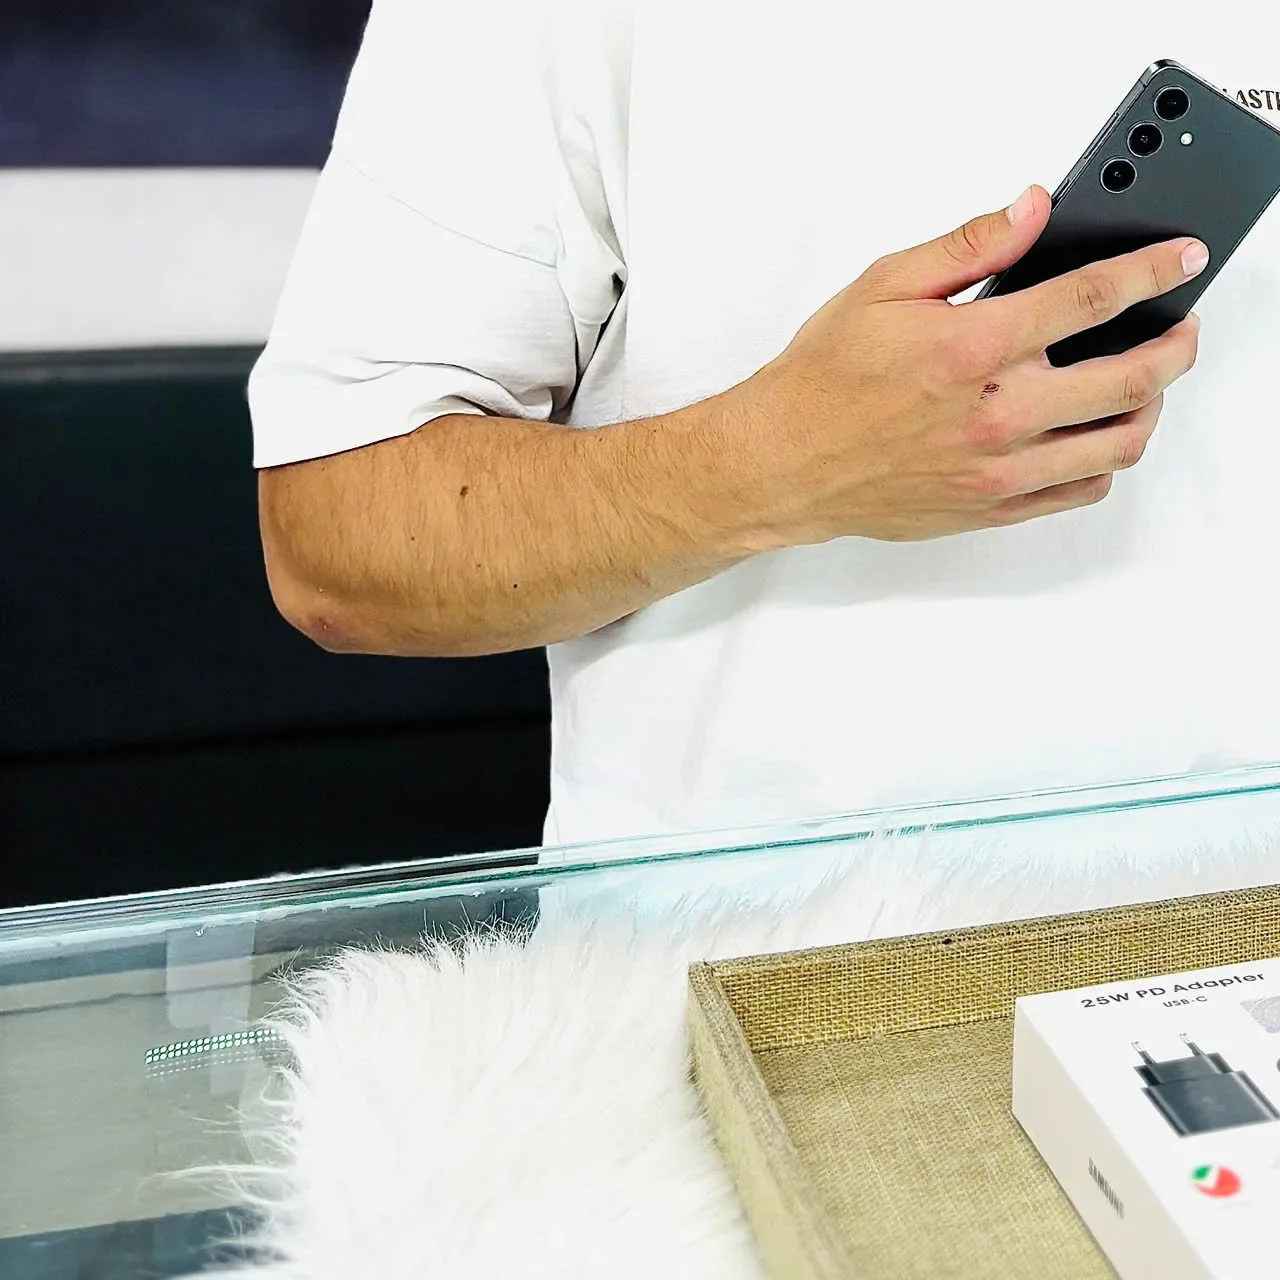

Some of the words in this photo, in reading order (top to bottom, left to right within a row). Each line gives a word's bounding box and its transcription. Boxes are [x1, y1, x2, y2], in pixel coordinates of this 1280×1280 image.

[1080, 992, 1129, 1008] 25W
[1136, 986, 1167, 998] PD
[1173, 972, 1265, 993] Adapter
[1163, 995, 1208, 1008] USB-C
